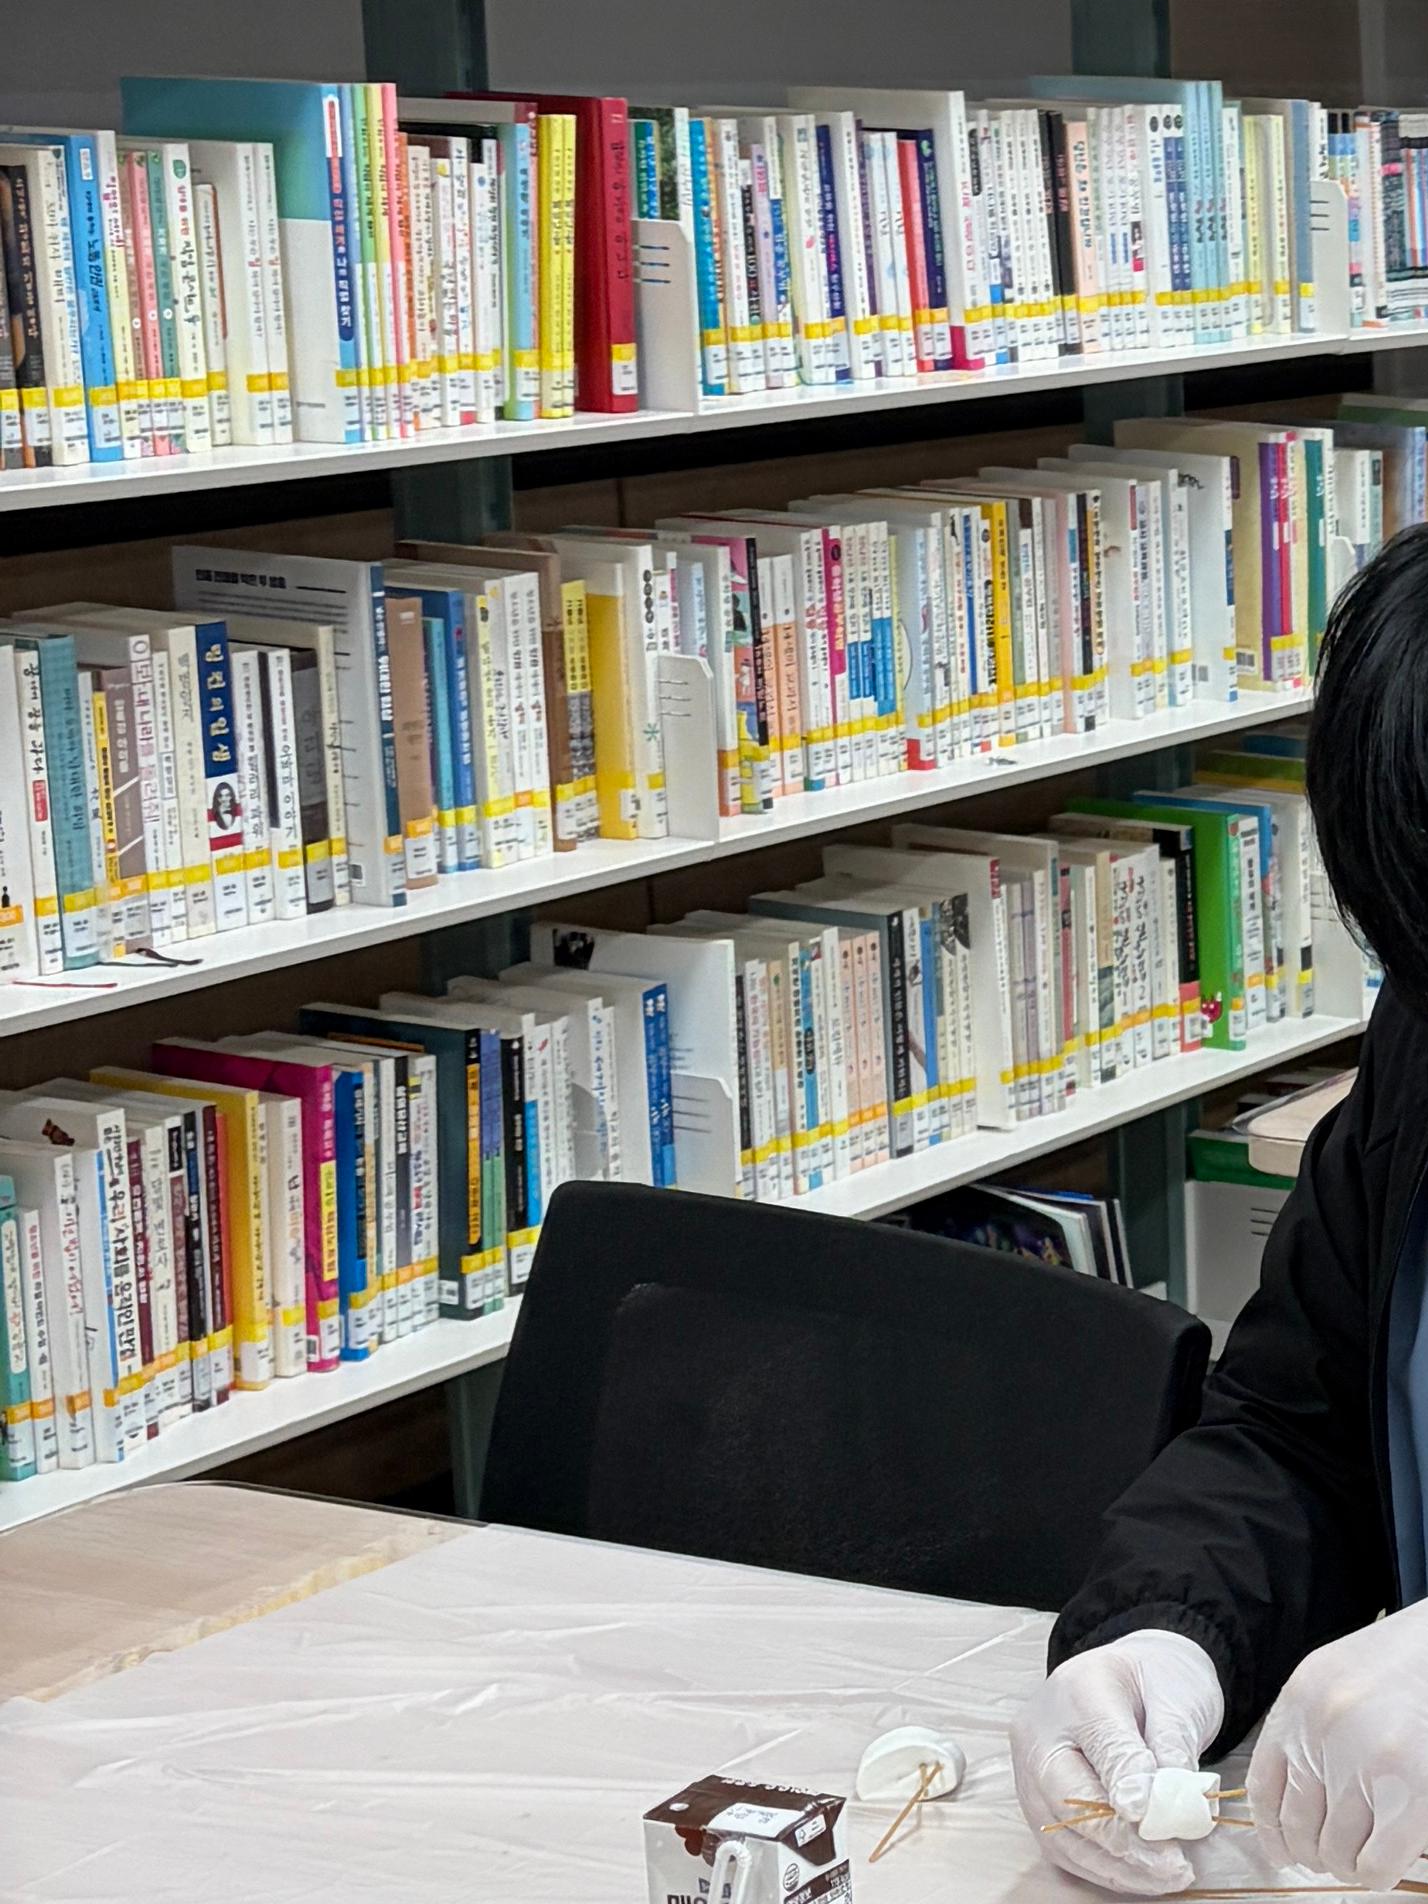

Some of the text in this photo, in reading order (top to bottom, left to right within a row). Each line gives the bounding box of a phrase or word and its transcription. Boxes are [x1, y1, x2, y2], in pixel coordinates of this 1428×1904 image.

[109, 1189, 138, 1362] 우리 사회를 움직인 판결
